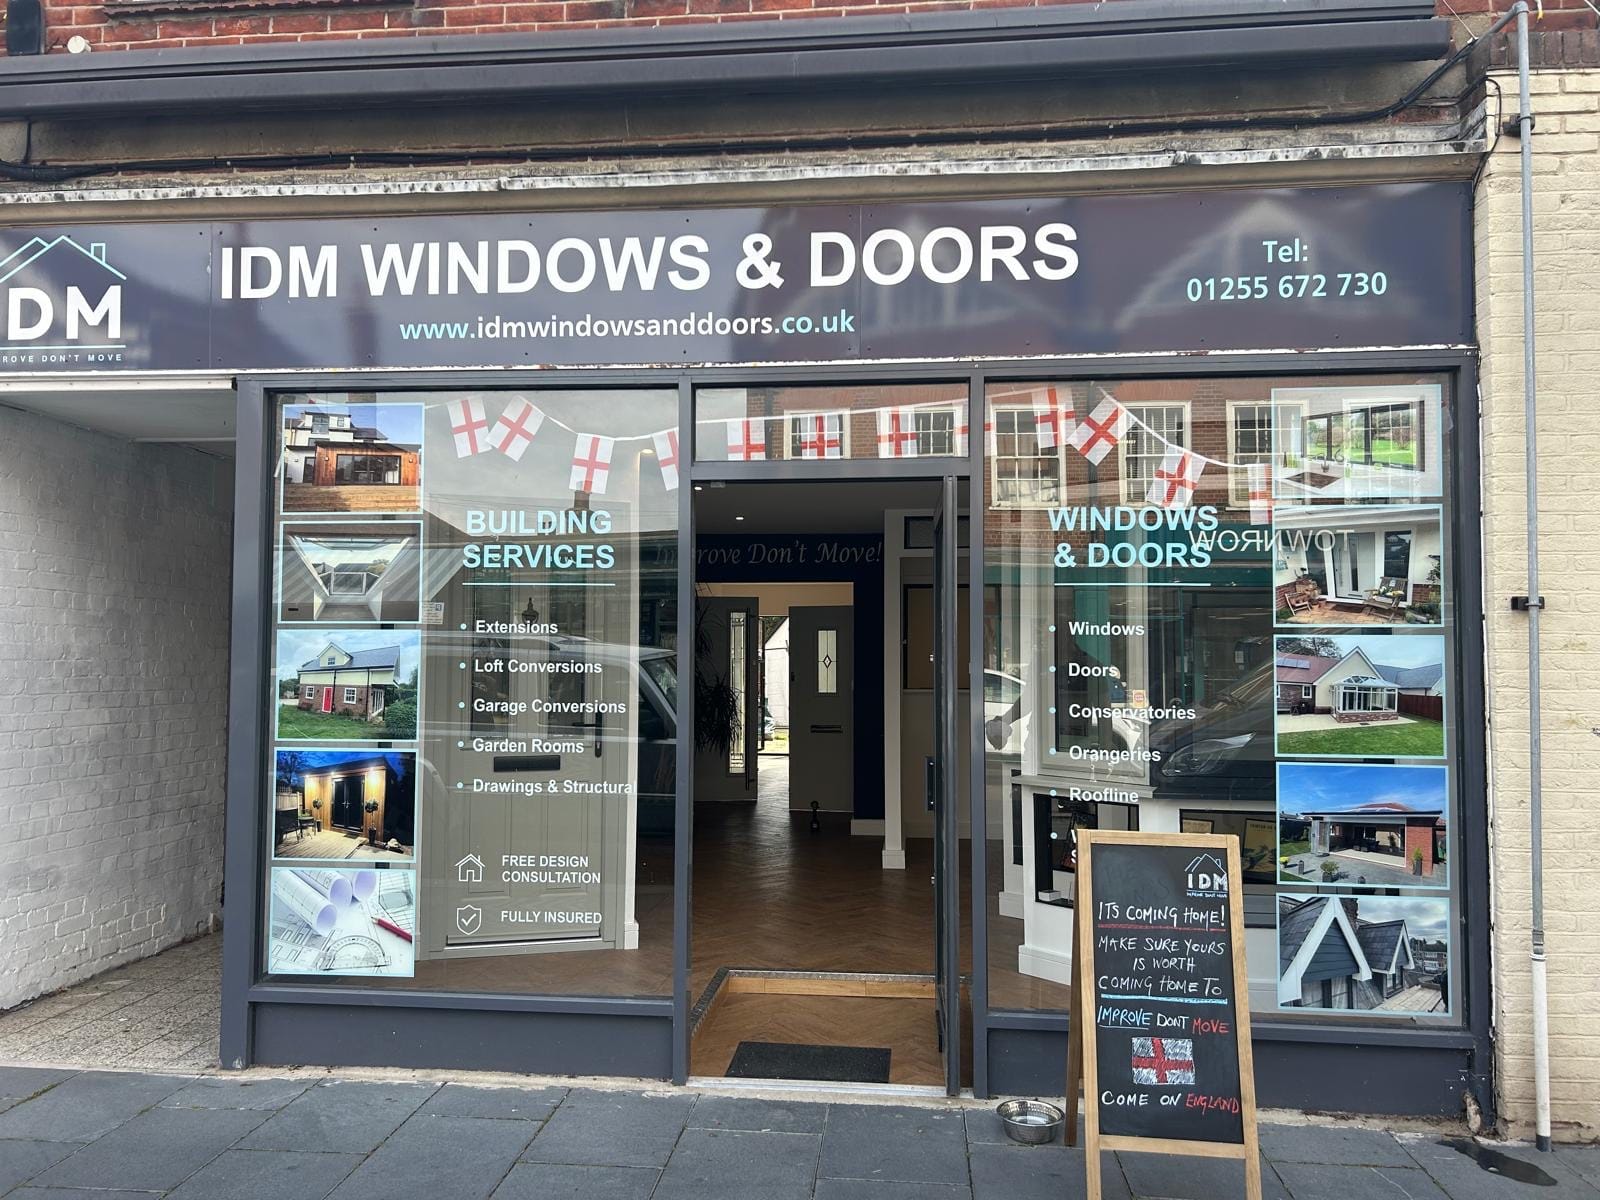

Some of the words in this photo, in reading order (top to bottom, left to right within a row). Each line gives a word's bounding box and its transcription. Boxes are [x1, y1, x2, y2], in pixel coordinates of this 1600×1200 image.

[1262, 238, 1309, 263] Tel:
[221, 245, 338, 299] IDM
[360, 235, 711, 296] WINDOWS
[735, 232, 785, 290] &
[810, 223, 1080, 287] DOORS
[1187, 276, 1269, 302] 01255
[1278, 274, 1327, 298] 672
[1336, 271, 1388, 296] 730
[400, 308, 855, 341] www.idmwindowsanddoors.co.uk
[88, 353, 122, 361] MOVE
[466, 510, 612, 534] BUILDING
[1048, 505, 1219, 531] WINDOWS
[463, 544, 615, 569] SERVICES
[815, 541, 882, 564] Move!
[1054, 543, 1077, 568] &
[1088, 542, 1212, 568] DOORS
[475, 620, 558, 634] Extensions
[1069, 622, 1145, 636] Windows
[474, 659, 504, 673] Loft
[507, 660, 602, 673] Conversions
[1068, 663, 1118, 677] Doors
[473, 699, 527, 715] Garage
[531, 700, 626, 714] Conversions
[1069, 704, 1196, 719] Conservatories
[472, 739, 527, 753] Garden
[531, 739, 585, 753] Rooms
[1069, 746, 1161, 763] Orangeries
[473, 779, 543, 796] Drawings
[548, 780, 559, 793] &
[1069, 788, 1139, 802] Roofline
[502, 855, 536, 867] FREE
[540, 856, 589, 867] DESIGN
[502, 871, 601, 884] CONSULTATION
[1188, 873, 1228, 891] IDM
[501, 911, 541, 923] FULLY
[544, 912, 602, 924] INSURED
[1099, 902, 1120, 920] ITS
[1126, 905, 1178, 927] COMING
[1183, 904, 1225, 931] HOME!
[1098, 935, 1138, 952] MAKE
[1143, 937, 1179, 953] SURE
[1184, 938, 1226, 956] YOURS
[1133, 957, 1145, 971] IS
[1152, 957, 1196, 973] WORTH
[1098, 975, 1153, 996] COMING
[1159, 975, 1199, 994] HOME
[1097, 1005, 1153, 1026] IMPROVE
[1192, 1017, 1230, 1035] MOVE
[1101, 1090, 1149, 1106] COME
[1160, 1093, 1182, 1106] ON
[1185, 1092, 1240, 1115] ENGLAND
